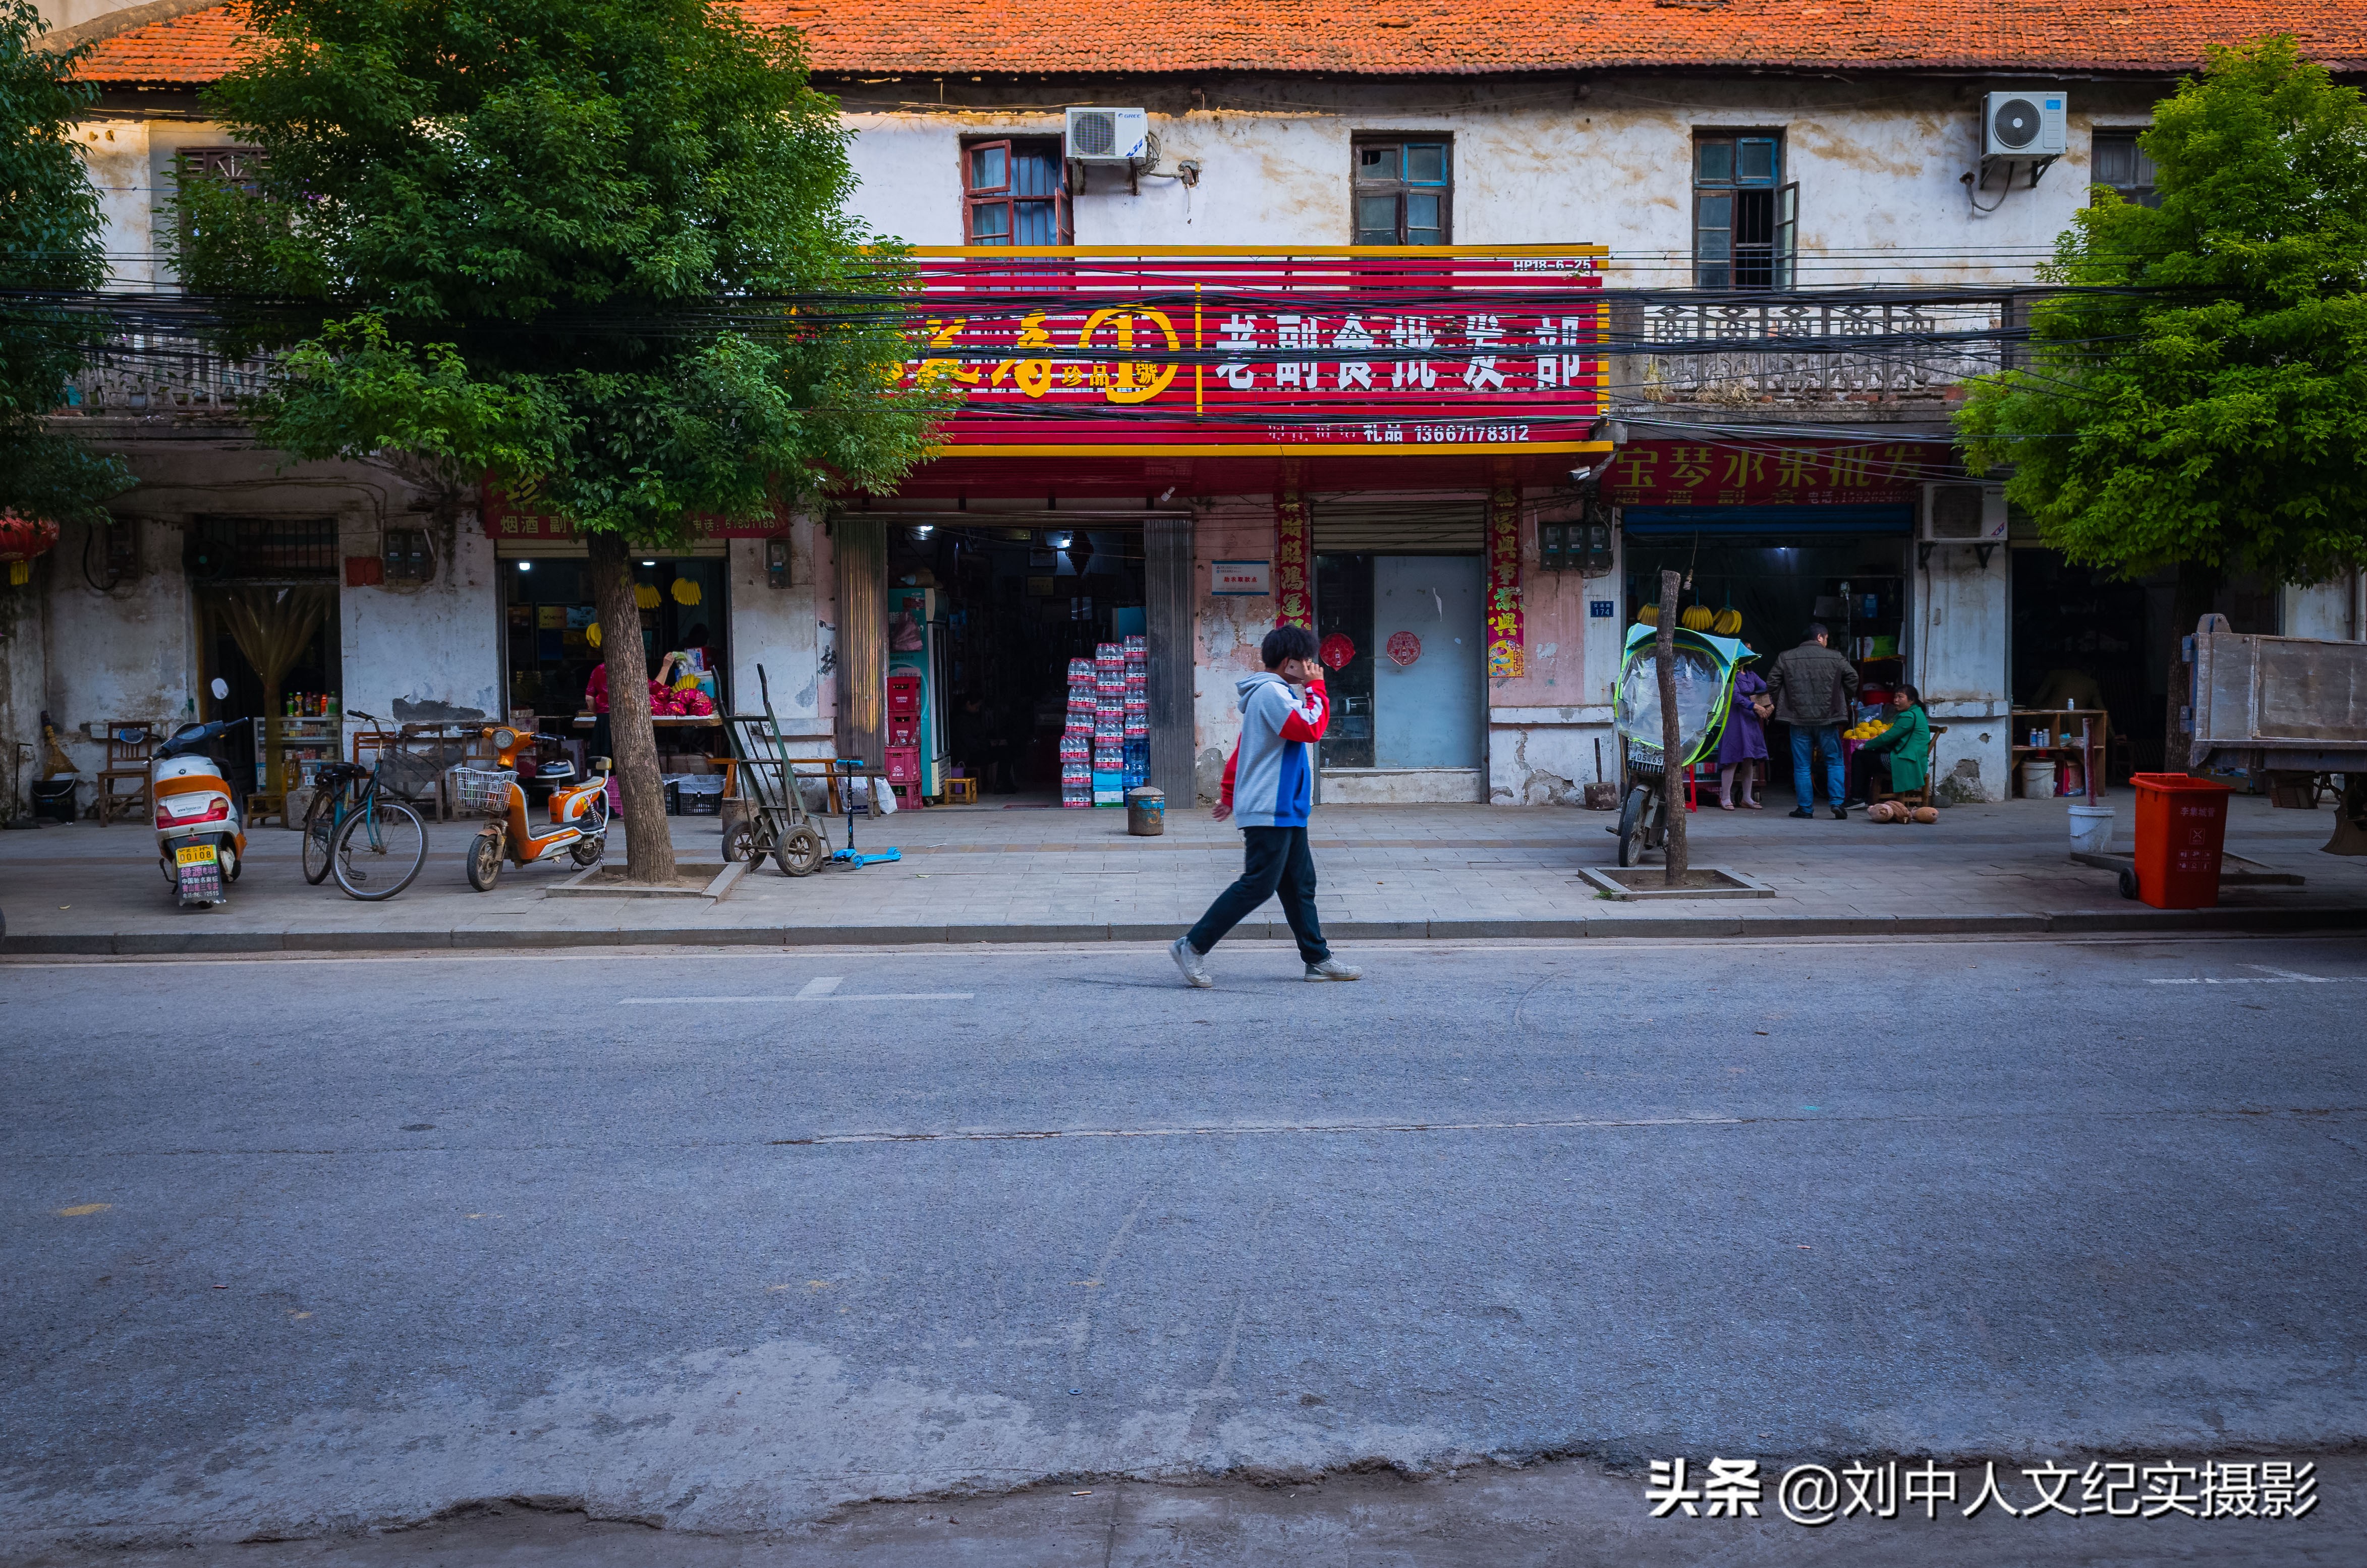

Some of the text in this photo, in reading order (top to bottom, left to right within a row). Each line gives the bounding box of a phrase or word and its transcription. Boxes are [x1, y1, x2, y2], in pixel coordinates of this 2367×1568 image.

[1513, 259, 1591, 270] HP18-6-25
[1363, 424, 1402, 442] 礼品
[1415, 425, 1529, 442] 13667178312
[1617, 446, 1928, 488] 宝琴水果批发
[500, 515, 539, 533] 烟酒
[1637, 754, 1662, 764] 0565
[180, 851, 211, 861] 00108
